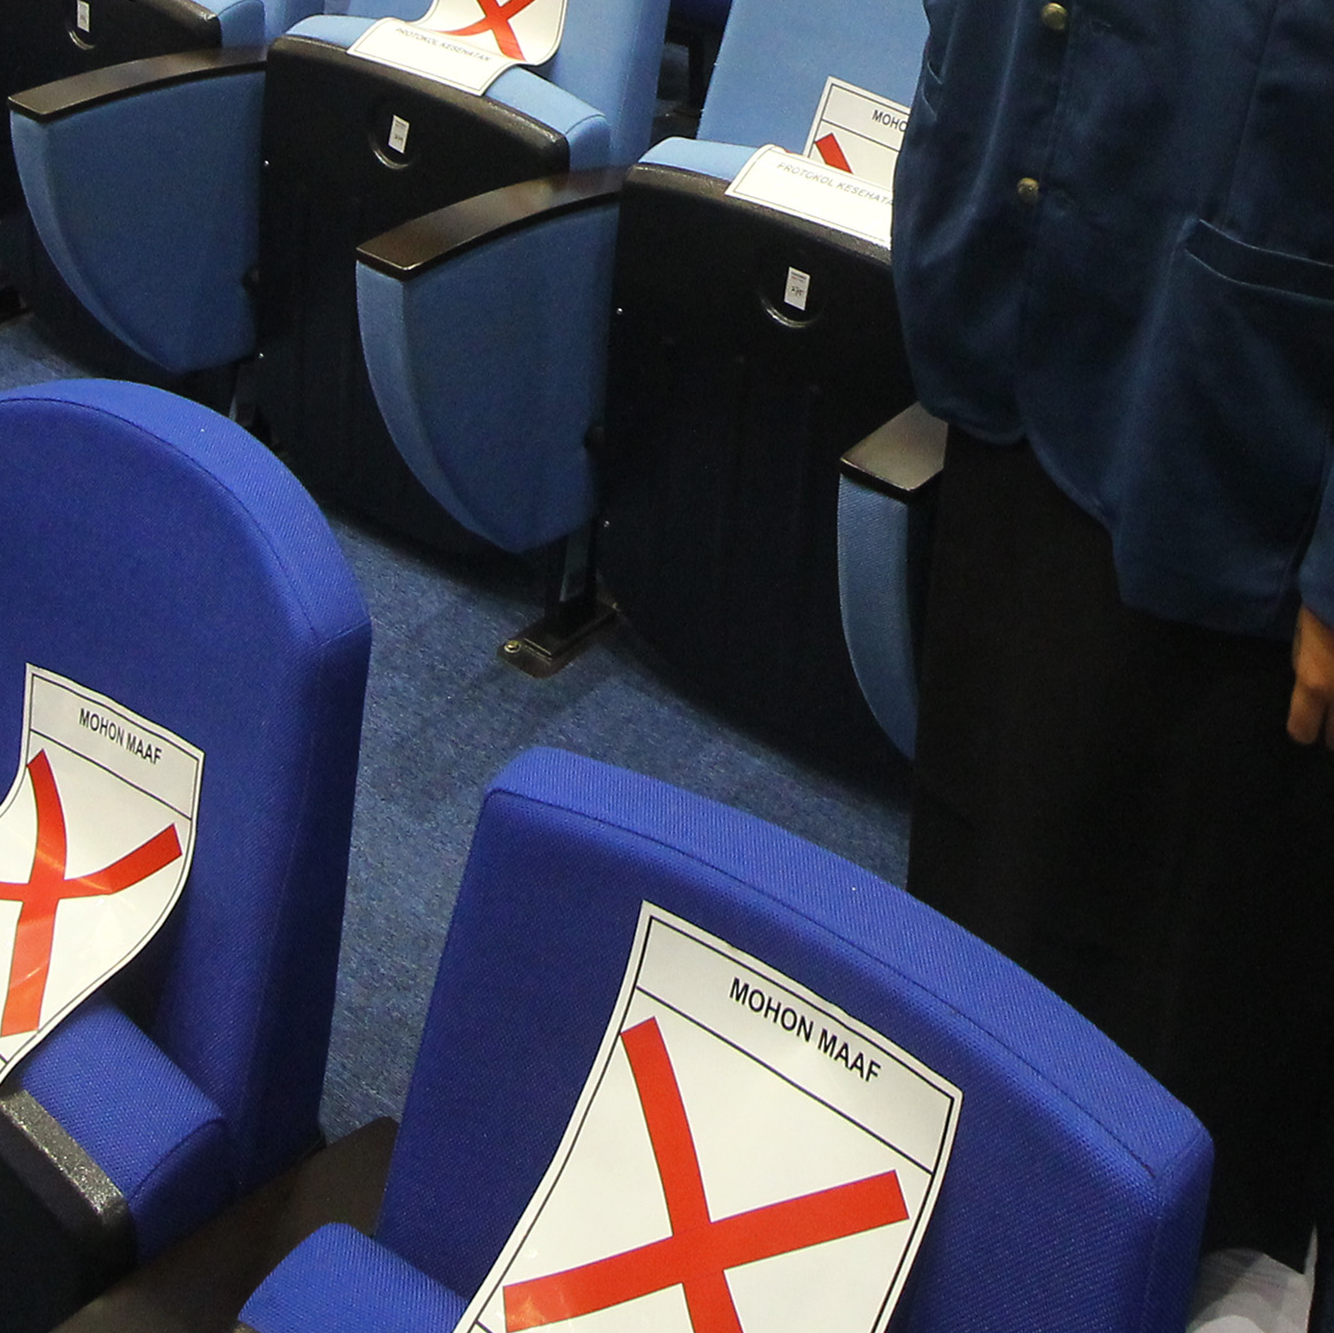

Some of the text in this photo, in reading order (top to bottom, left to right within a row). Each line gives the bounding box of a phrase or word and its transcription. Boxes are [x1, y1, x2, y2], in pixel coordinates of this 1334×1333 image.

[872, 109, 909, 133] MOHO
[777, 162, 895, 207] PROTOKOL KESEHATA
[79, 707, 162, 765] MOHON MAAF
[729, 976, 882, 1082] MOHON MAAF
